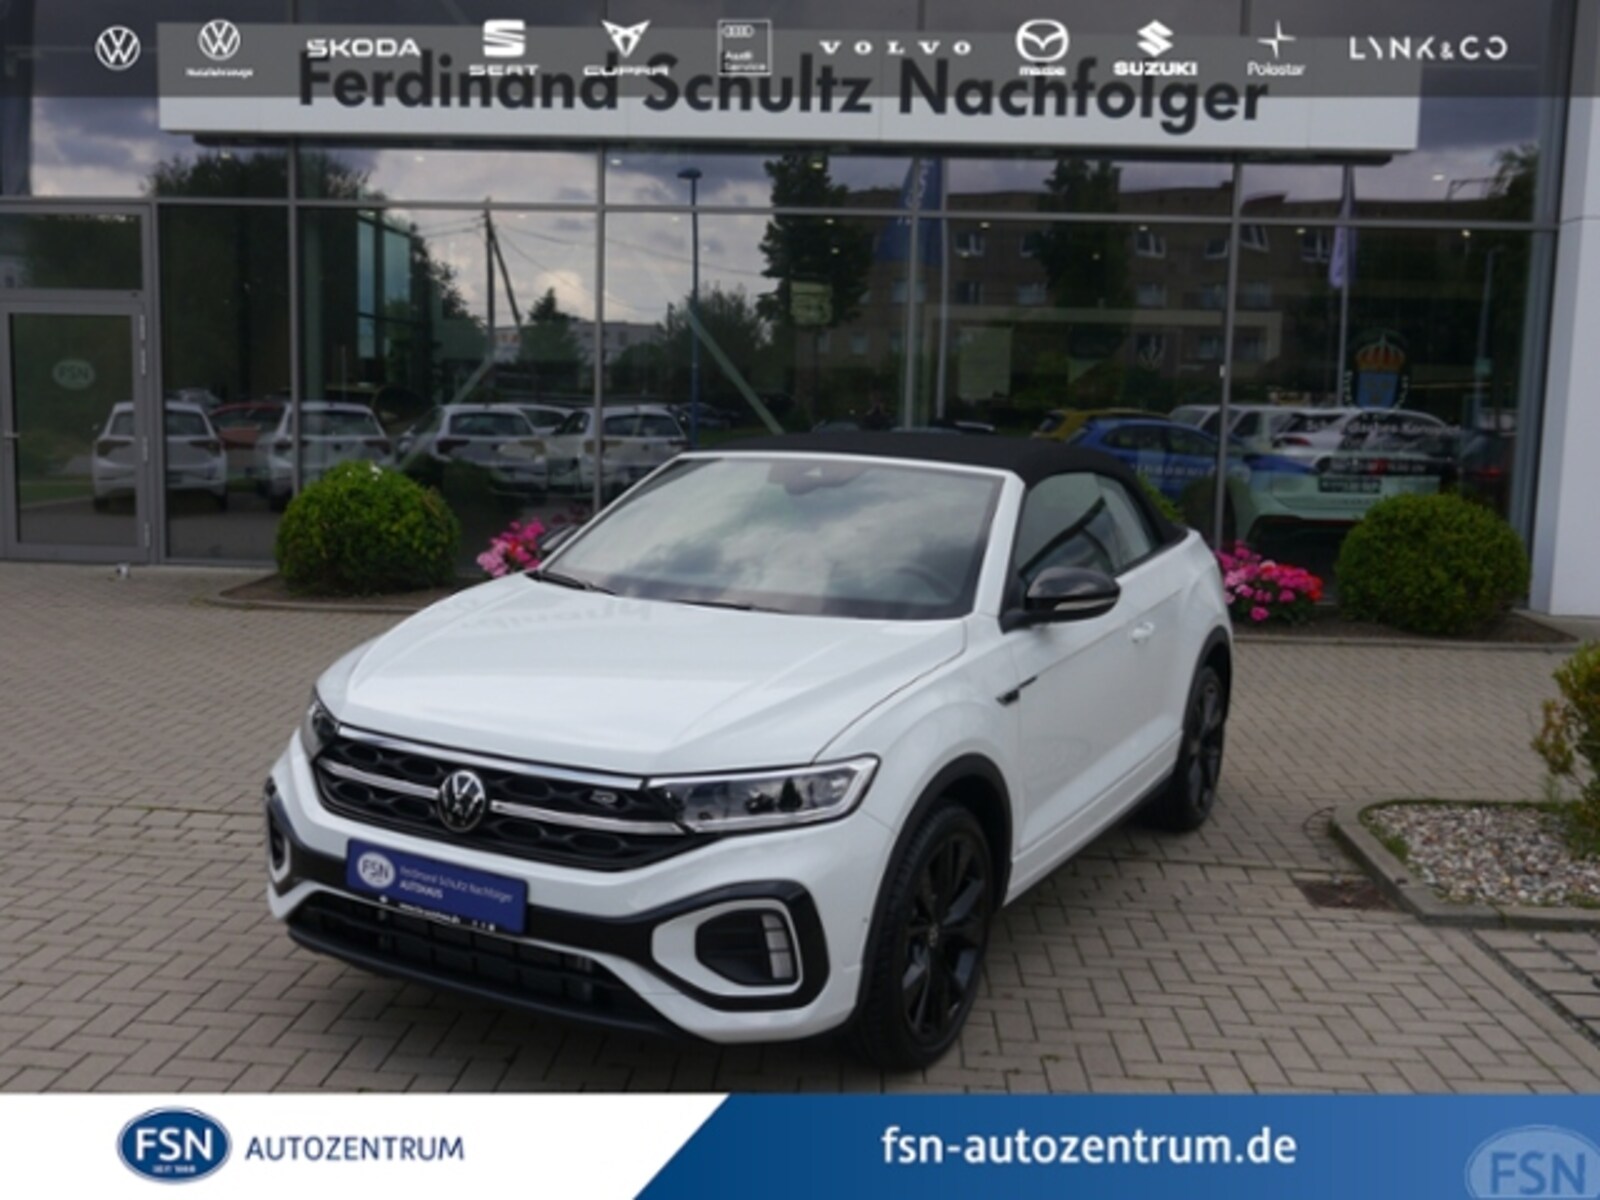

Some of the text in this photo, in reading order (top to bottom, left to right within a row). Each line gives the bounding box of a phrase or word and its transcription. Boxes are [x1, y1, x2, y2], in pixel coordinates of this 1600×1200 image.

[300, 50, 1269, 134] Ferdinand Schultz Nachfolger
[361, 858, 390, 880] FSN
